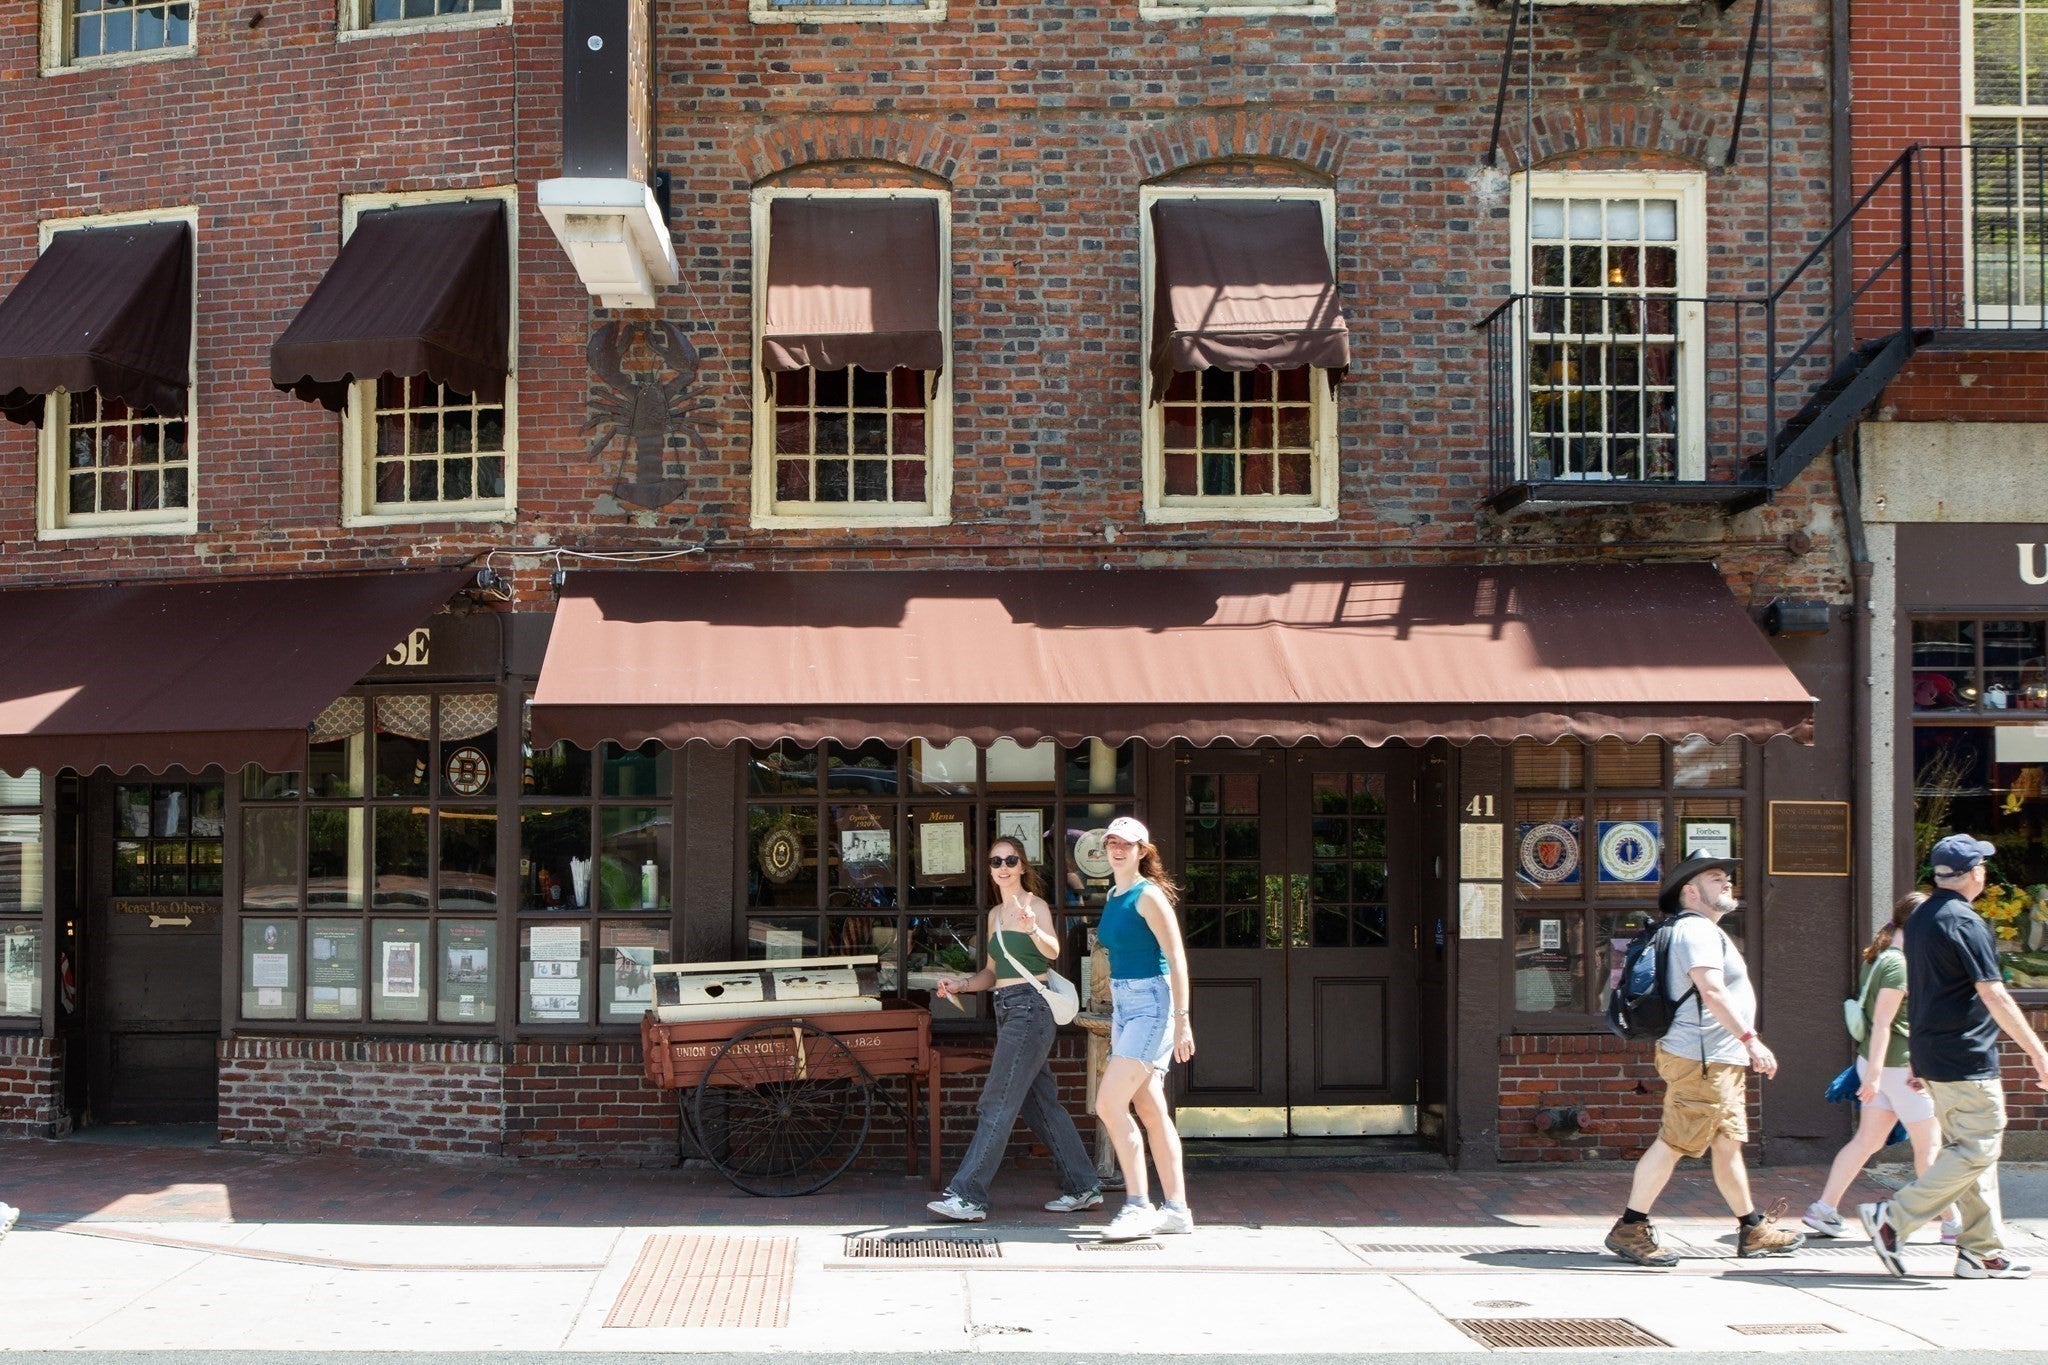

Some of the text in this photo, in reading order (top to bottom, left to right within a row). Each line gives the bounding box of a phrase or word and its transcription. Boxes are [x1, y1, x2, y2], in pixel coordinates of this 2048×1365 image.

[2016, 543, 2048, 585] U
[1466, 795, 1495, 817] 41
[928, 811, 955, 821] Menu
[1696, 827, 1721, 835] Forbes
[116, 901, 150, 913] Please
[676, 1046, 706, 1057] UNION
[710, 1044, 750, 1057] OYER
